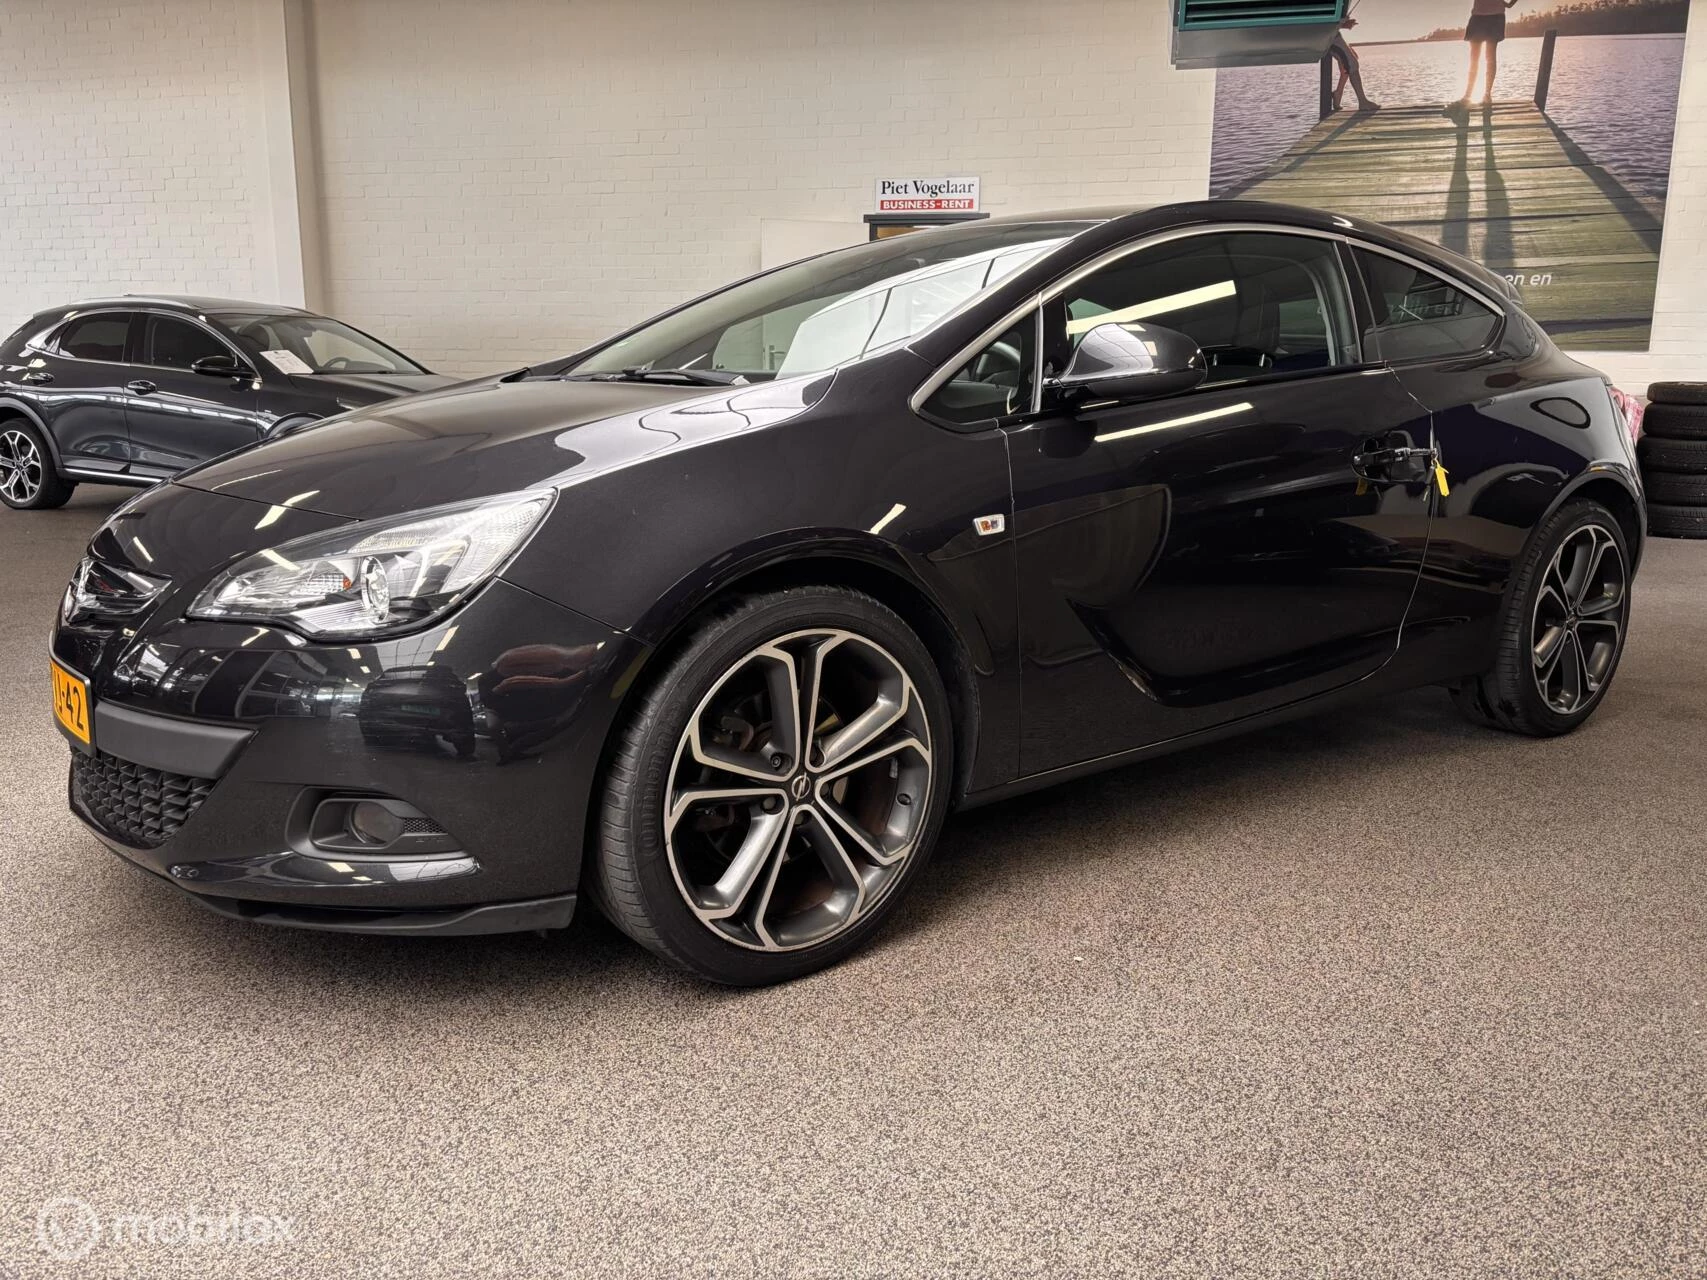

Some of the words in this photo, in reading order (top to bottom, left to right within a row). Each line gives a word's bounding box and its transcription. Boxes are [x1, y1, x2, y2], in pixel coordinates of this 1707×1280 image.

[880, 180, 909, 195] Piet
[913, 179, 975, 198] Vogelaar
[883, 200, 970, 209] BUSINESS-RENT
[1530, 274, 1552, 286] en
